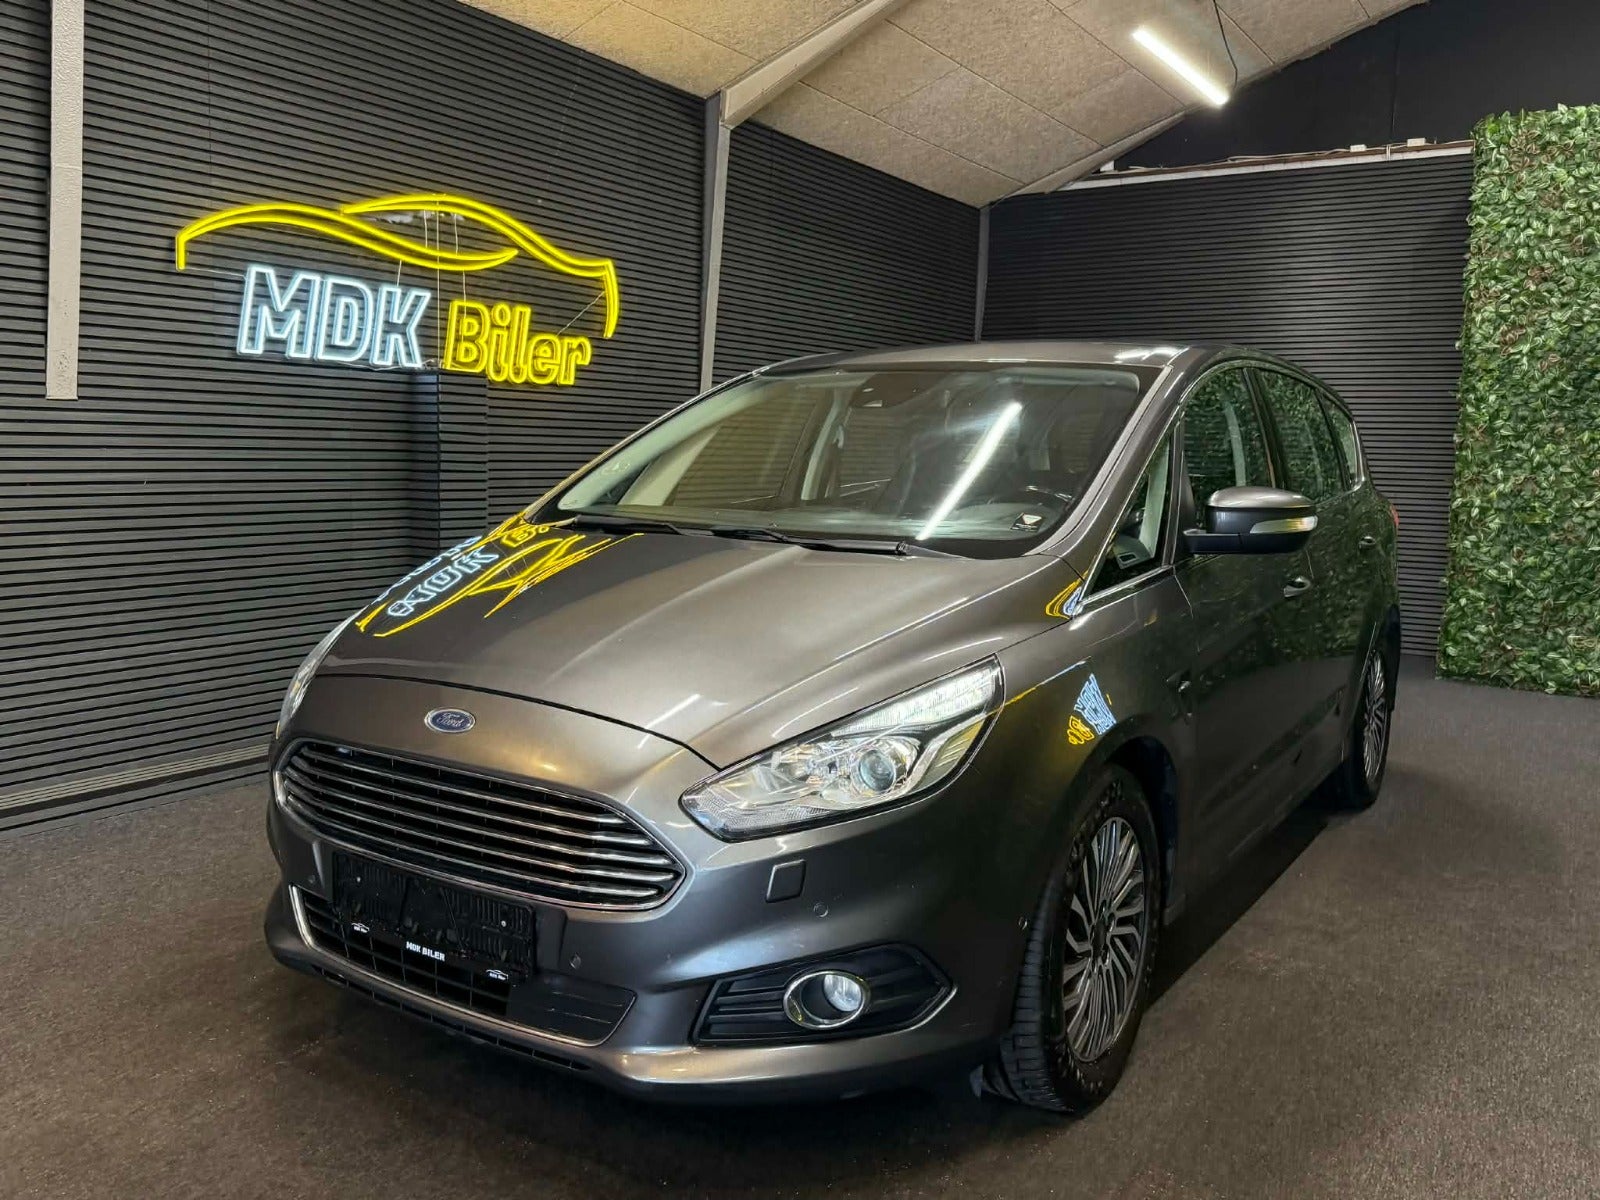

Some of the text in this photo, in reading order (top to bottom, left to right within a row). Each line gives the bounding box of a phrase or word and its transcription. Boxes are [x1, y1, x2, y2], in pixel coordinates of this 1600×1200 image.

[237, 265, 592, 385] MDK Biler
[436, 712, 465, 728] Ford
[422, 947, 446, 962] BILER
